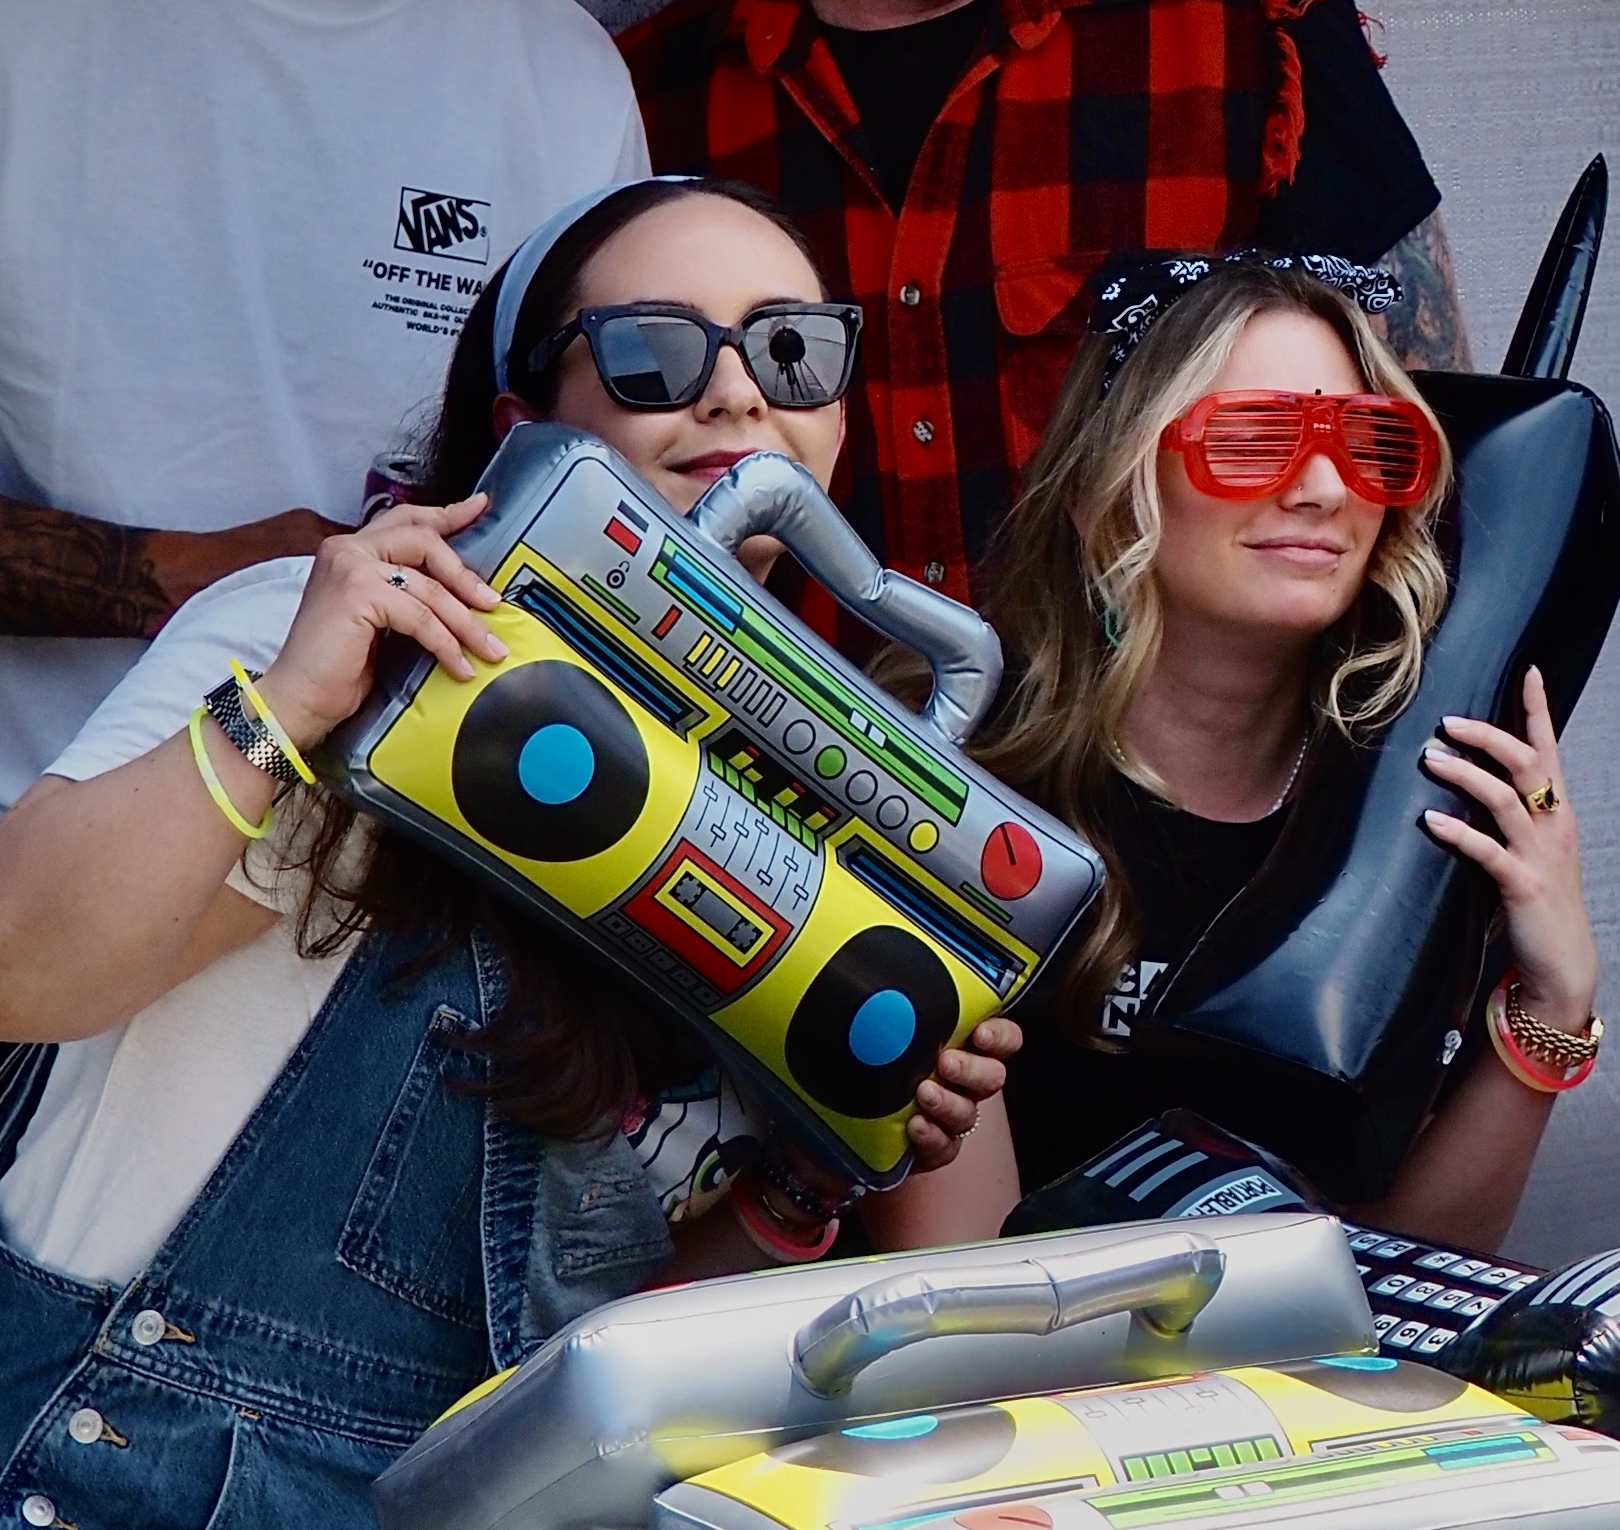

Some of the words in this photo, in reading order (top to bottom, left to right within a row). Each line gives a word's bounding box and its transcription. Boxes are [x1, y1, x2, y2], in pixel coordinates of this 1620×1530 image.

[399, 190, 480, 253] VANS
[414, 269, 453, 292] THE
[456, 276, 486, 297] WA
[371, 300, 419, 316] AUTHENTIC
[384, 293, 401, 304] THE
[401, 297, 438, 311] ORIGINAL
[406, 320, 449, 337] WORLD'S
